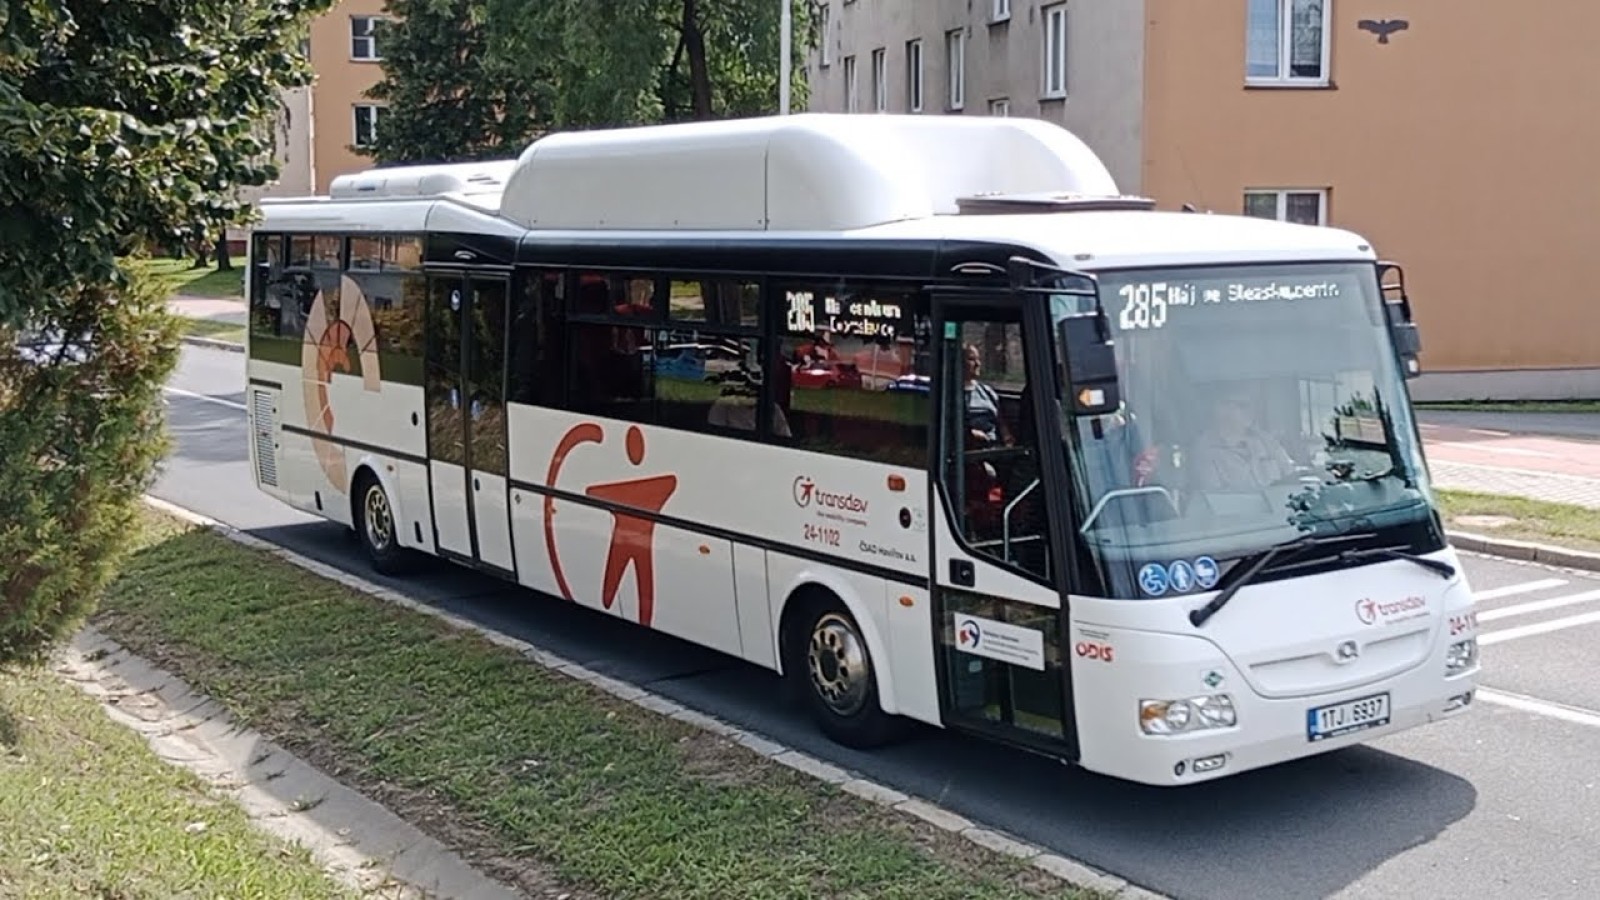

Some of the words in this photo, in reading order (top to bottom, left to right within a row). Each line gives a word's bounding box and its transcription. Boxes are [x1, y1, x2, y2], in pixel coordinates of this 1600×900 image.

[786, 291, 815, 333] 285
[1119, 282, 1167, 329] 285
[815, 488, 868, 513] transdev
[803, 523, 840, 547] 24-1102
[1377, 594, 1426, 616] transdev
[1076, 642, 1113, 662] ODIS
[1321, 707, 1345, 728] 1TJ
[1353, 698, 1383, 721] 6937
